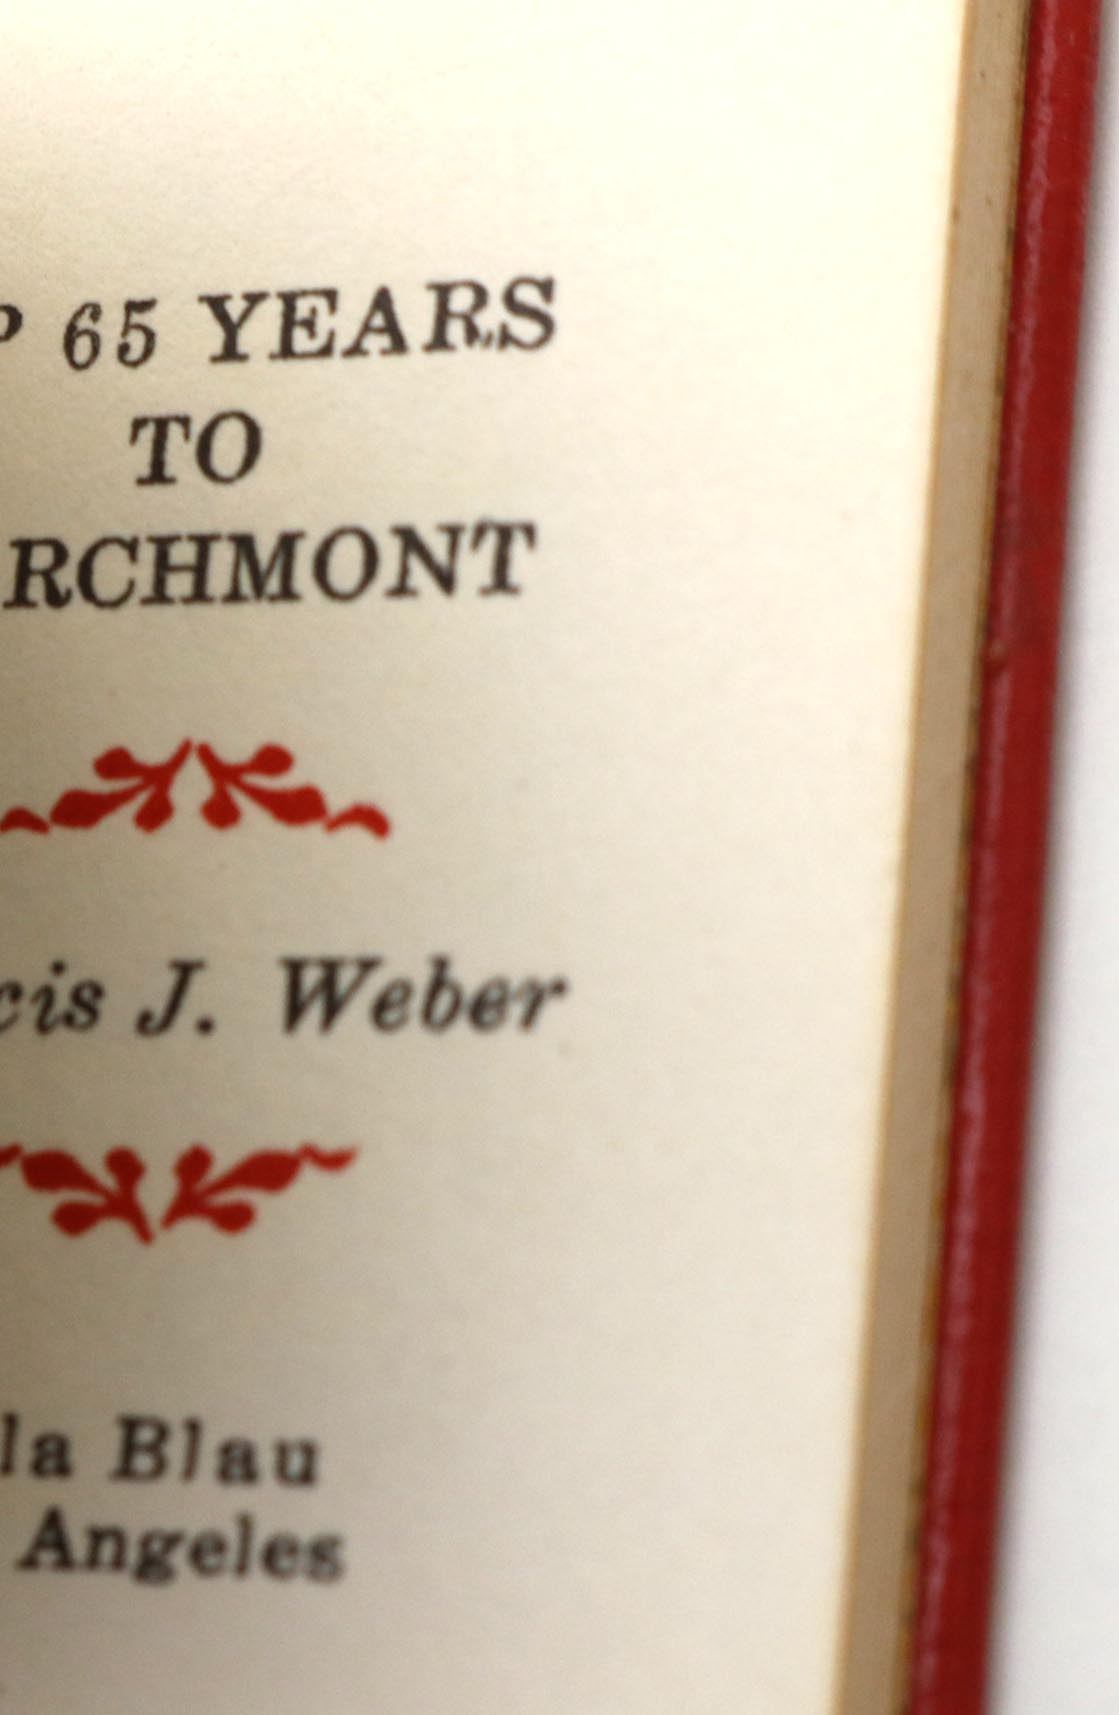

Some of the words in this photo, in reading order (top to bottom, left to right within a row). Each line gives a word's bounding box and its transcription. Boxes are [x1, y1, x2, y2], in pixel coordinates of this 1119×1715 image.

[63, 299, 157, 371] 65
[198, 276, 556, 363] YEARS
[130, 411, 262, 486] TO
[135, 960, 215, 1036] J.
[280, 957, 570, 1033] Weber
[112, 1416, 320, 1487] Blau
[17, 1506, 345, 1583] Angeles
